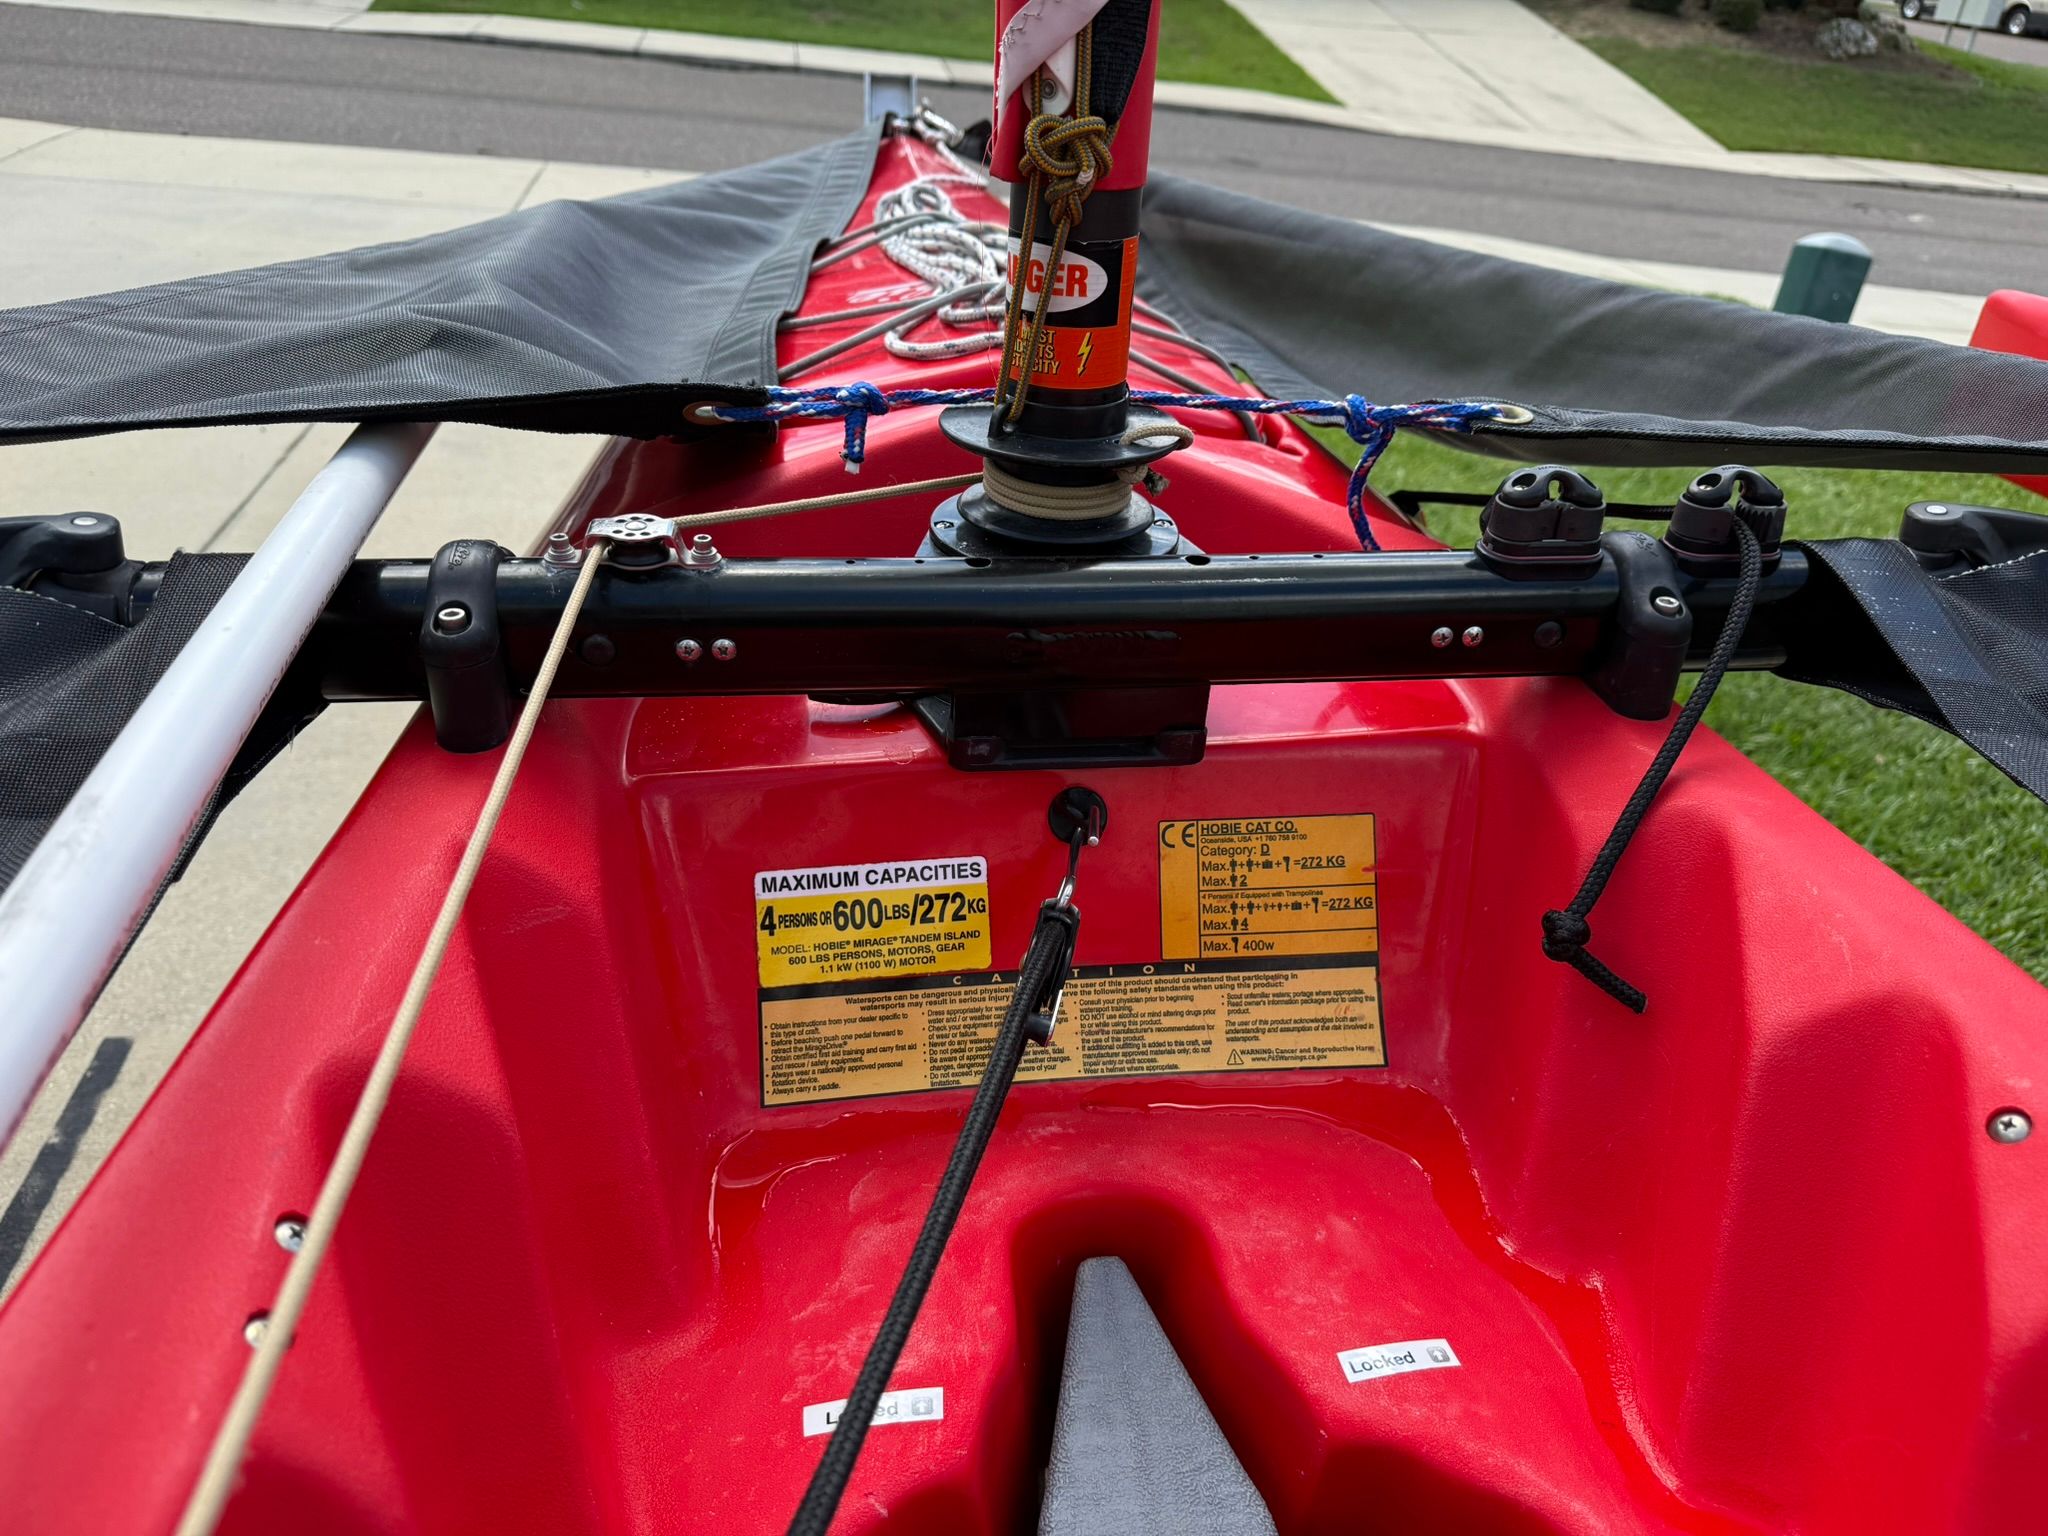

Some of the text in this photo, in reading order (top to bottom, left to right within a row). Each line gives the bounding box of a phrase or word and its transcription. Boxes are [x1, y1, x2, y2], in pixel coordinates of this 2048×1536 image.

[1161, 823, 1195, 848] CE
[1201, 821, 1298, 835] HOBIE CAT CO.
[1200, 844, 1270, 858] Category: D
[1202, 861, 1229, 872] Max.
[1326, 856, 1345, 867] KG
[761, 862, 982, 893] MAXIMUM CAPACITIES
[1202, 875, 1248, 887] Max. 2
[1202, 904, 1230, 914] Max.
[1354, 897, 1373, 908] KG
[760, 906, 776, 936] 4
[778, 912, 817, 929] PERSONS
[820, 911, 832, 925] OR
[1203, 918, 1248, 930] Max. 4
[771, 945, 811, 956] MODEL:
[900, 934, 941, 944] TANDEM
[944, 930, 980, 940] ISLAND
[1204, 940, 1274, 951] Max. 400w
[788, 943, 965, 965] 600 LBS PERSONS, MOTORS, GEAR
[820, 956, 936, 974] 1.1 kW (1100 W) MOTOR
[1093, 987, 1128, 996] following
[1129, 986, 1152, 995] safety
[1214, 983, 1235, 991] using
[1252, 981, 1284, 989] product:
[1124, 978, 1153, 987] product
[921, 990, 962, 1000] dangerous
[988, 994, 1009, 1003] injury
[1348, 1351, 1416, 1374] Locked
[826, 1401, 898, 1424] Led
